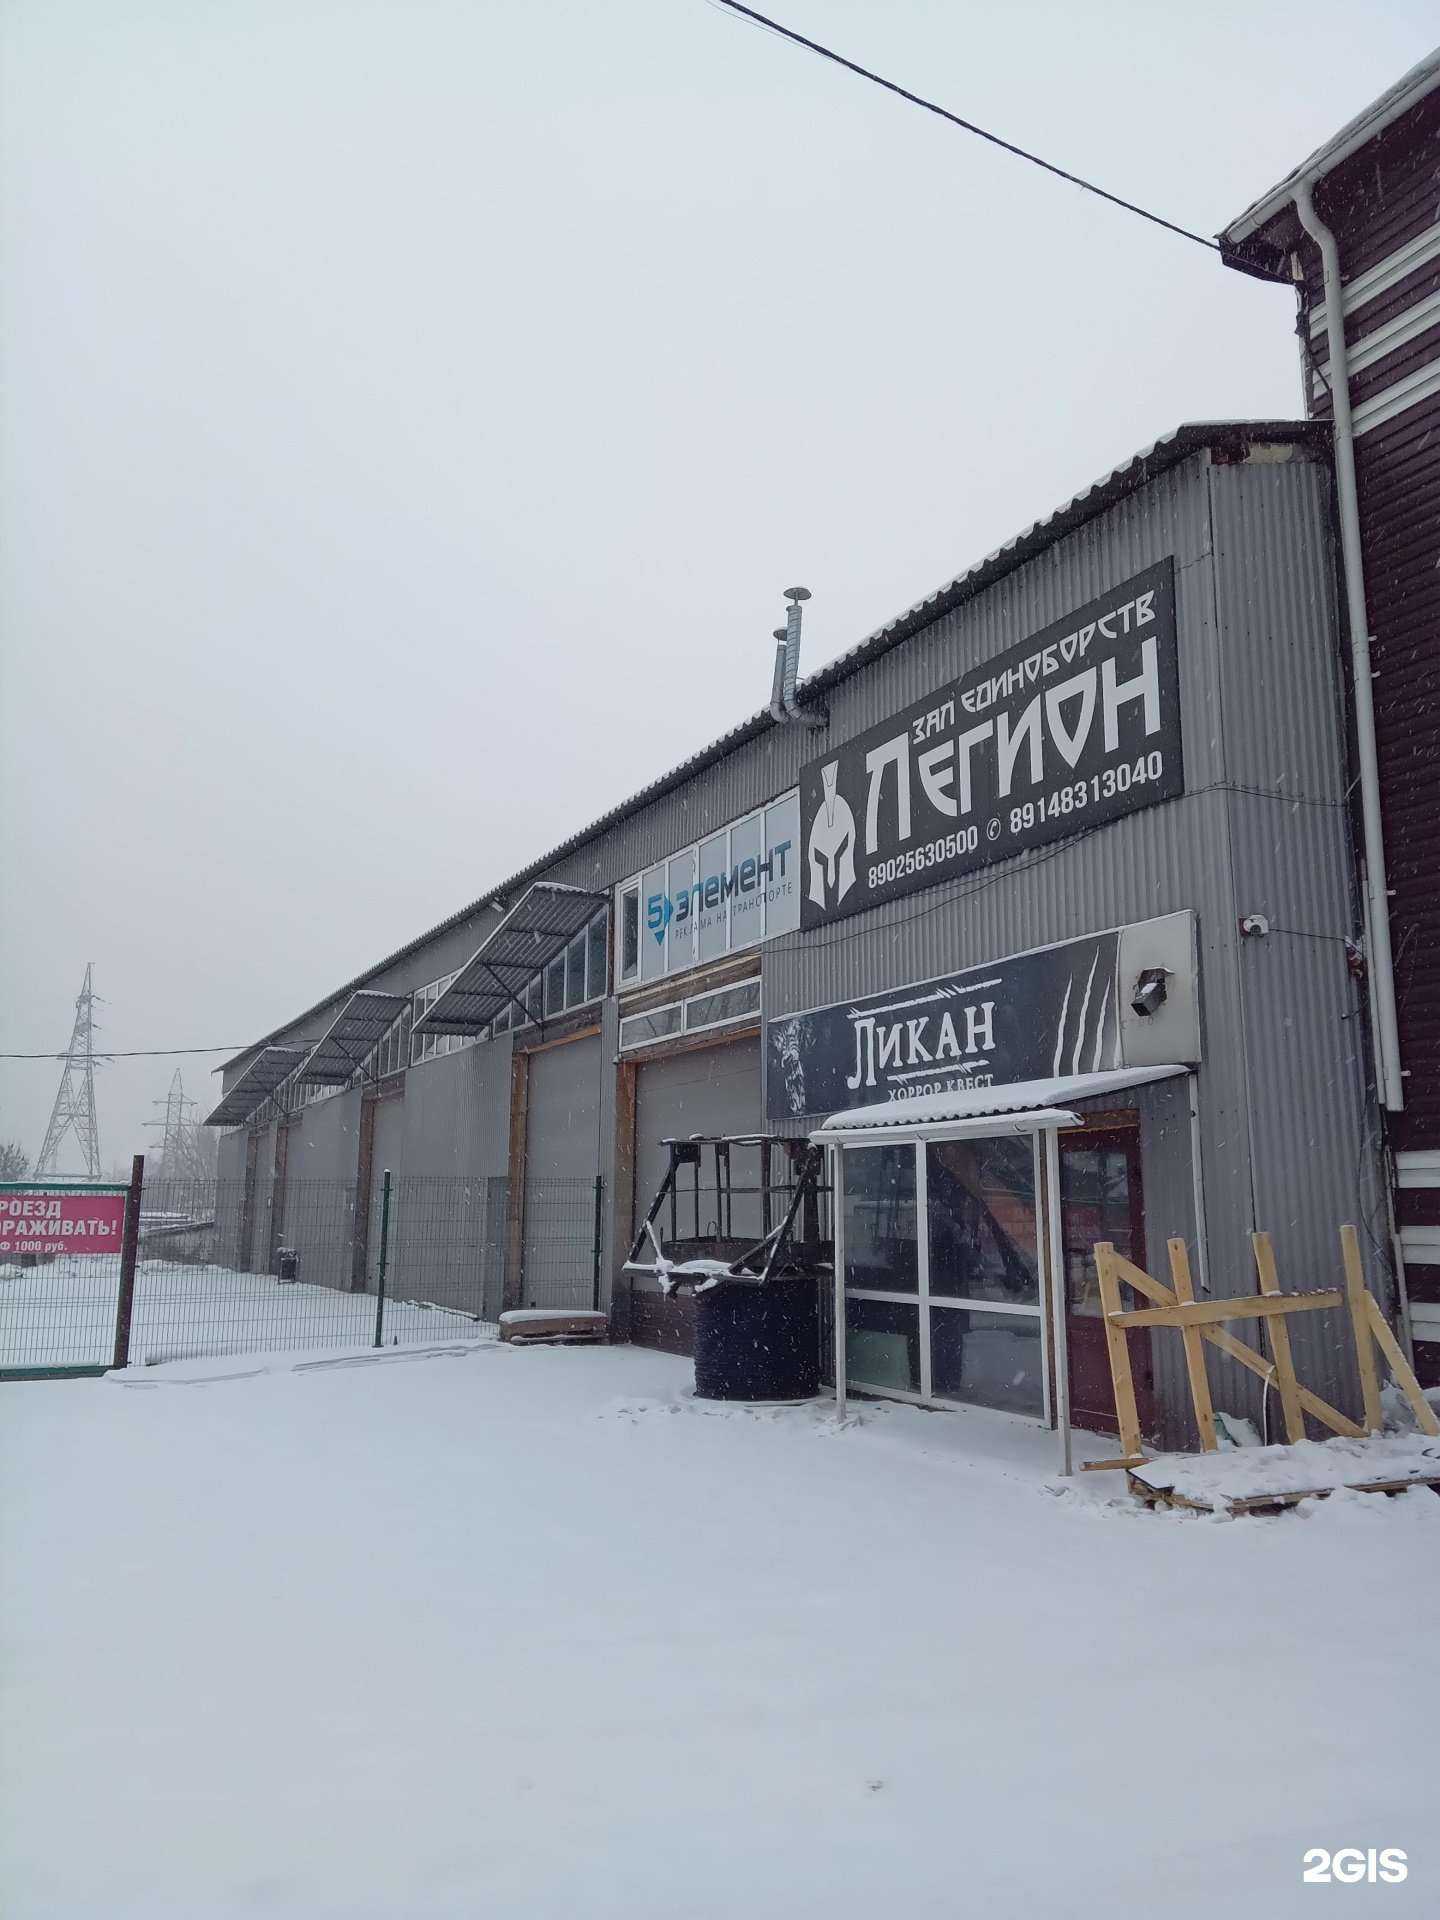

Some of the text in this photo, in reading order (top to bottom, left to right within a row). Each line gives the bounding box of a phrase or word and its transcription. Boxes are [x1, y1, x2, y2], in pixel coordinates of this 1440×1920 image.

[912, 590, 1156, 744] ЗАЛ ЕДИНОБОРСТВ
[866, 636, 1161, 855] ЛЕГИОН
[868, 751, 1163, 889] 89025630500 89148313040
[888, 1074, 994, 1104] ХОРРОР КВЕСТ
[0, 1219, 118, 1236] РАЖИВАТЬ!
[15, 1240, 42, 1252] 1000
[45, 1241, 68, 1253] руб.
